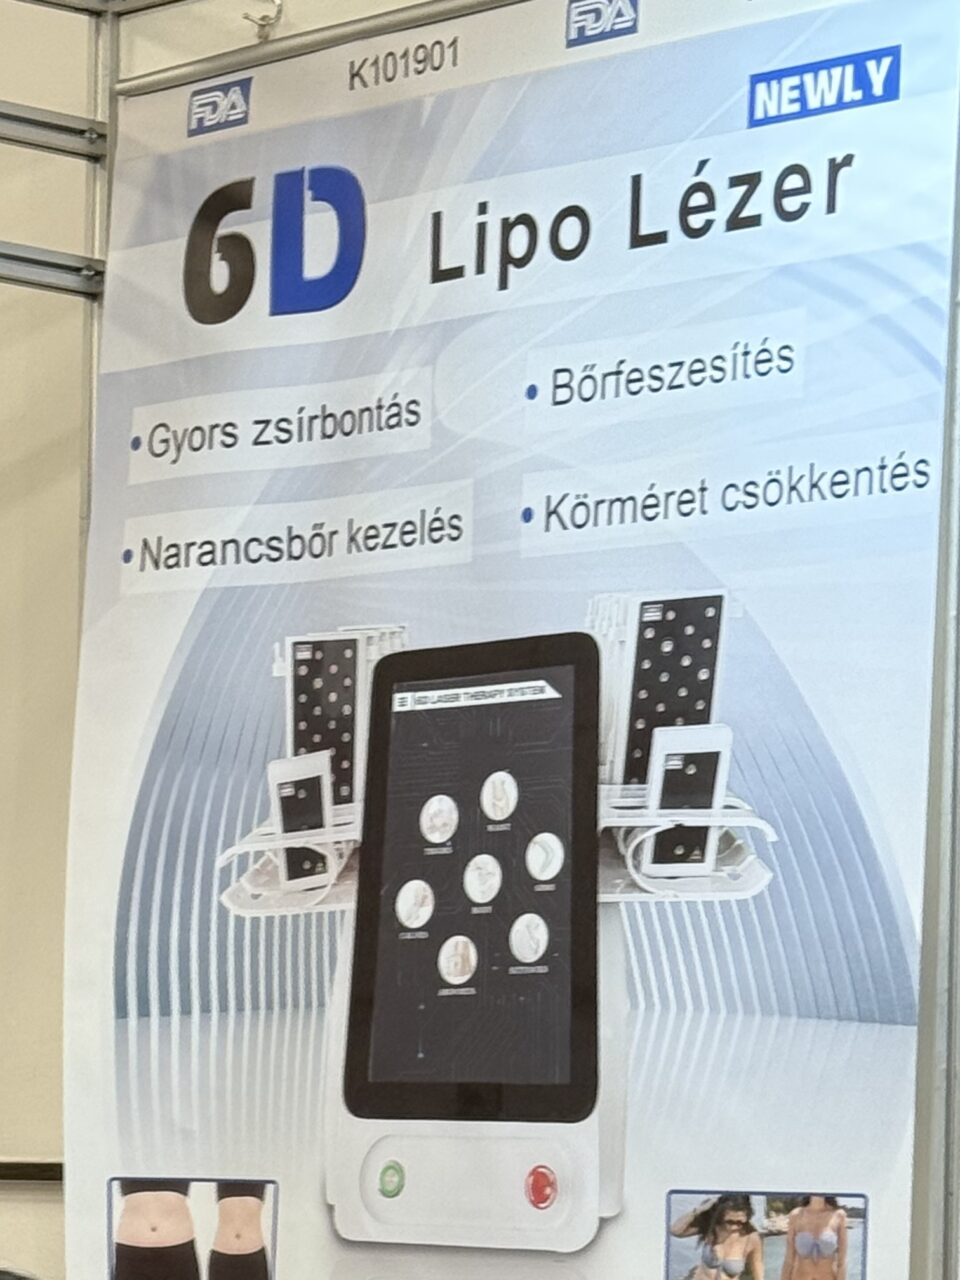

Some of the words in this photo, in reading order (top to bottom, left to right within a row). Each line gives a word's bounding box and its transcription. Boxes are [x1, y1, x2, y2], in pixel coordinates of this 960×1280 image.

[568, 0, 637, 41] FDA
[348, 36, 460, 91] K101901
[752, 55, 894, 120] NEWLY
[190, 86, 248, 130] FDA
[183, 165, 367, 325] 6D
[430, 200, 591, 291] Lipo
[628, 153, 855, 250] Lézer
[550, 336, 795, 406] Bőrfeszesítés
[147, 420, 239, 465] Gyors
[252, 392, 422, 447] zsírbontás
[544, 478, 709, 532] Körméret
[720, 450, 931, 513] csökkentés
[139, 521, 338, 572] Narancsbőr
[346, 506, 464, 554] kezelés
